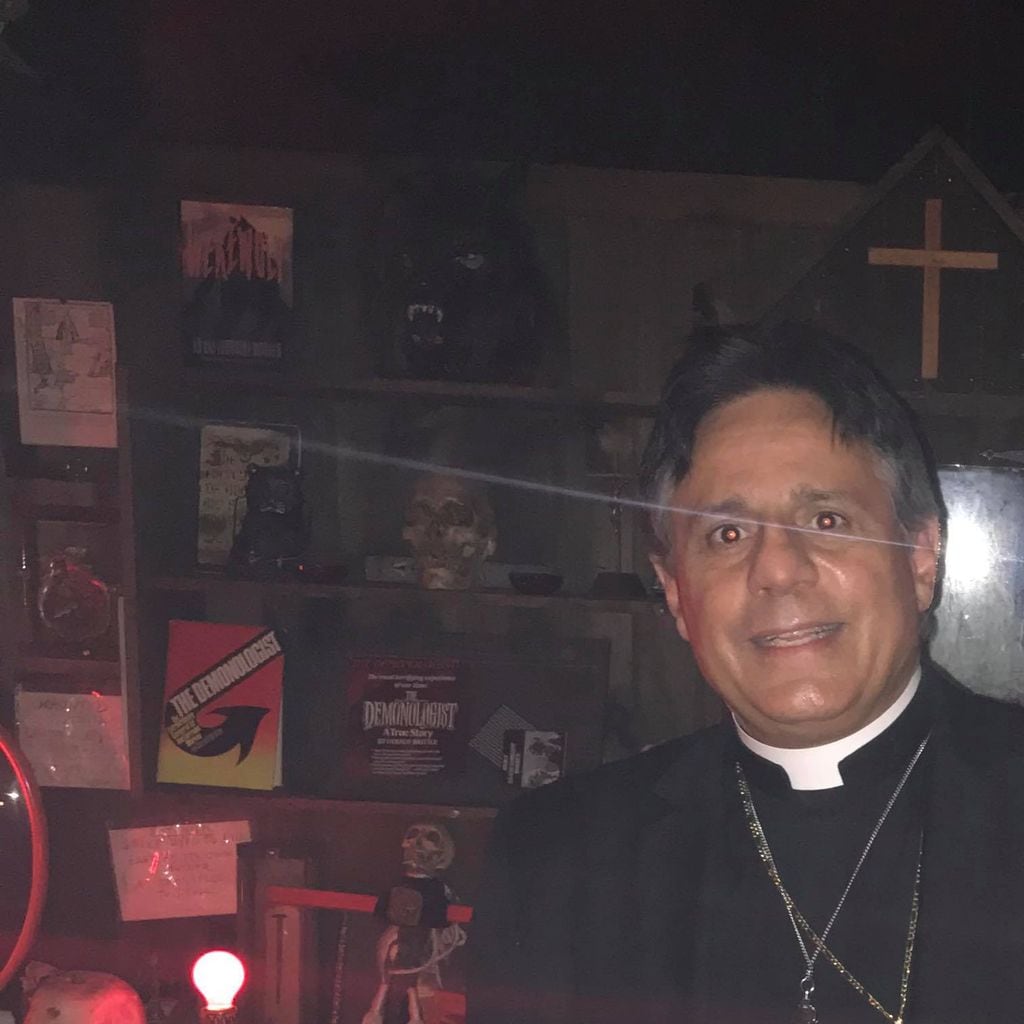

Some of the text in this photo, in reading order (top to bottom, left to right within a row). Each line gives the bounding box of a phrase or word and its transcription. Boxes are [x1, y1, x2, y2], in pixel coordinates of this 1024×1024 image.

[169, 630, 282, 718] THE DEMONOLOGIST
[362, 700, 459, 731] DEMONOLOGIST
[409, 728, 434, 740] Story
